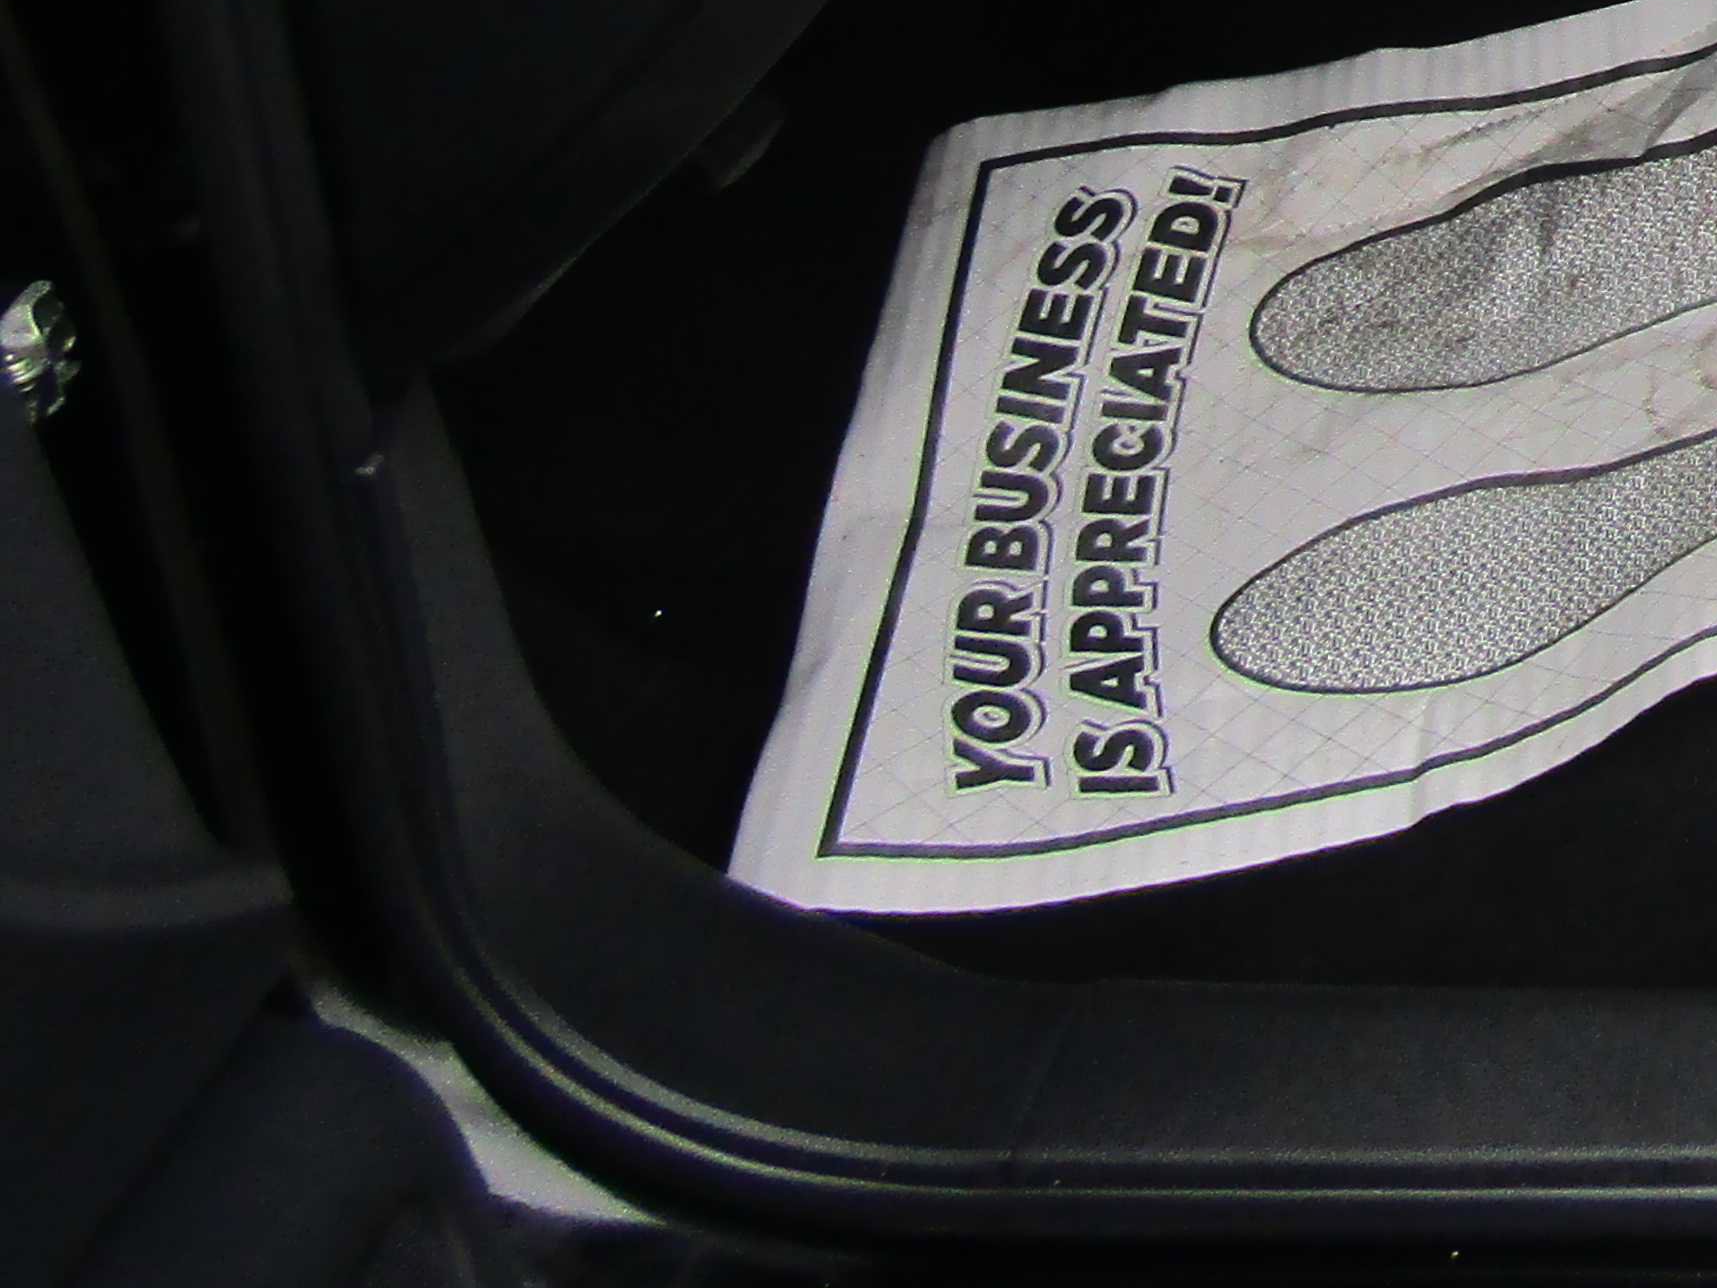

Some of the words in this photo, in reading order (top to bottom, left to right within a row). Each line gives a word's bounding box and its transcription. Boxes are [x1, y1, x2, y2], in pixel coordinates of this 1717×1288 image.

[963, 188, 1137, 572] BUSINESS
[1067, 169, 1244, 716] APPRECIATED!
[951, 581, 1049, 791] YOUR
[1072, 722, 1174, 794] IS
